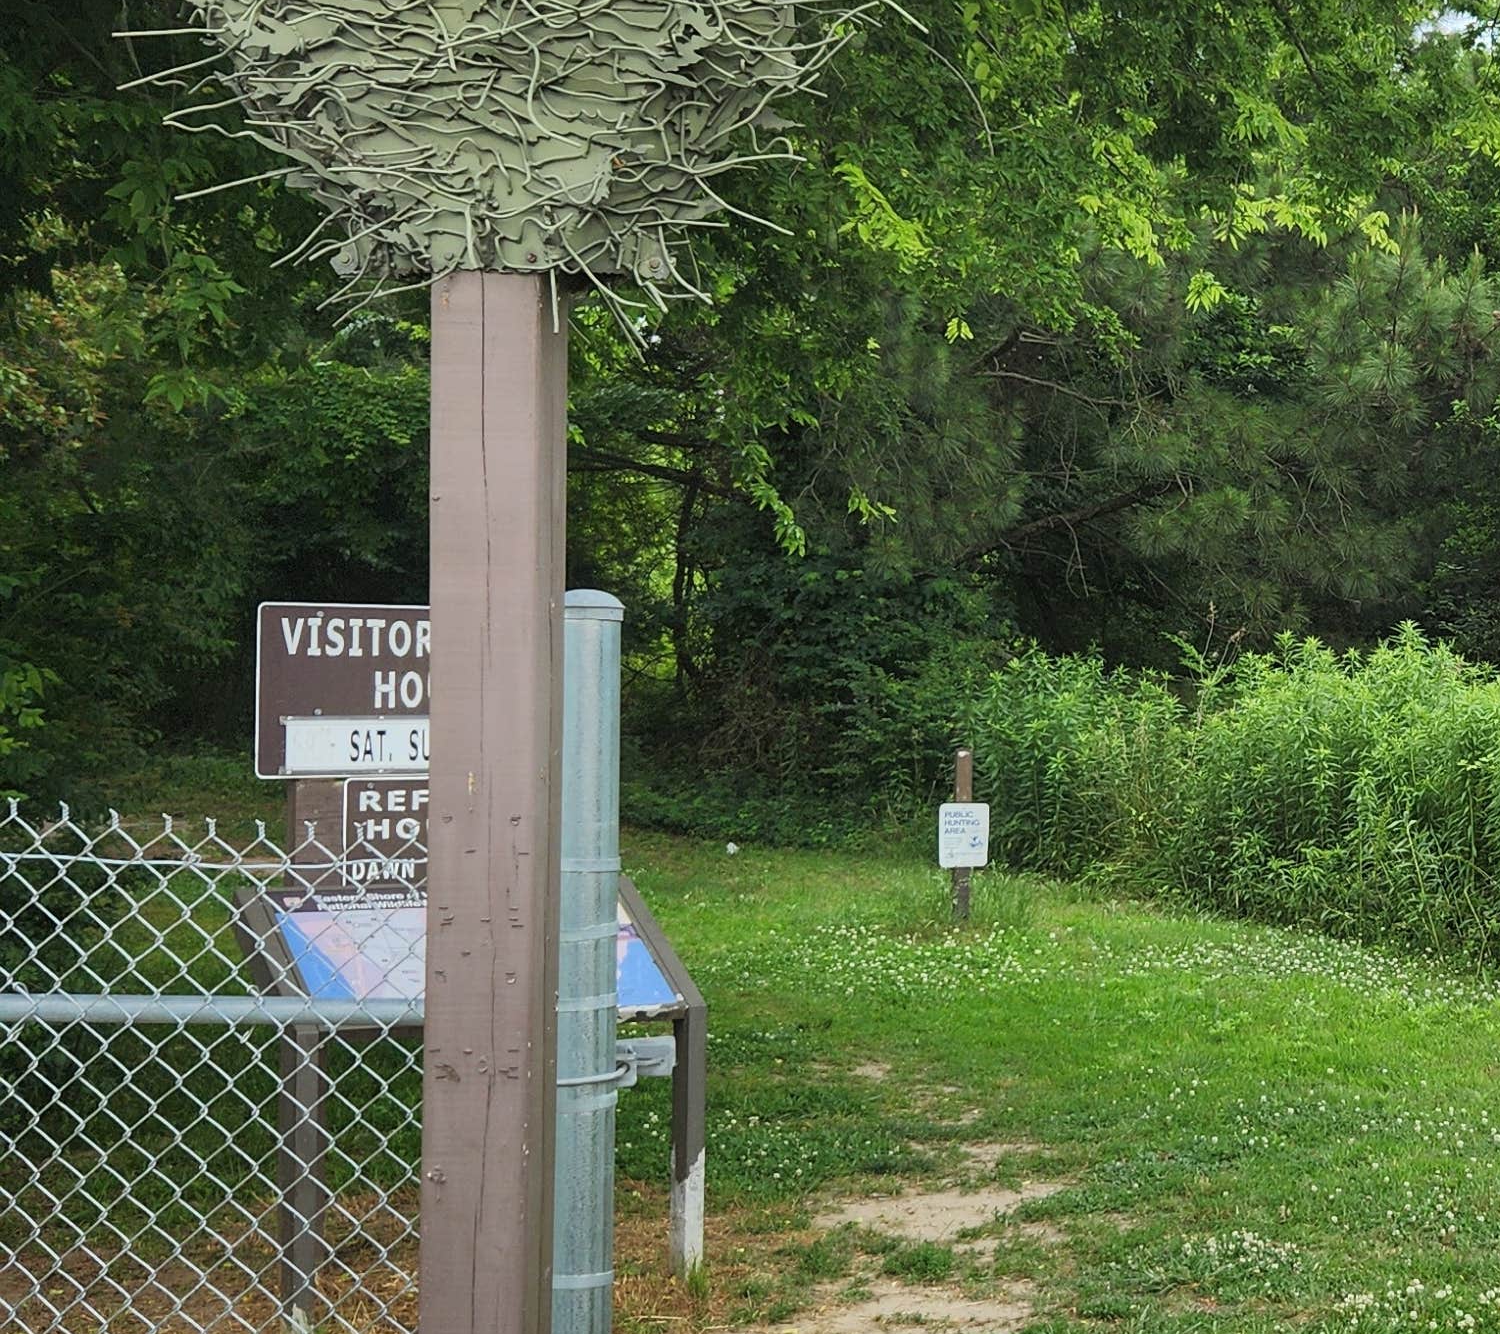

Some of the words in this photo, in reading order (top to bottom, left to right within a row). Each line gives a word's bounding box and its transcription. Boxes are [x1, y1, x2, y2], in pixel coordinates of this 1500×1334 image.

[281, 617, 431, 658] VISITOR
[359, 789, 430, 812] REF
[944, 810, 974, 818] PUBLIC
[944, 827, 966, 835] AREA
[352, 859, 416, 881] DAWN
